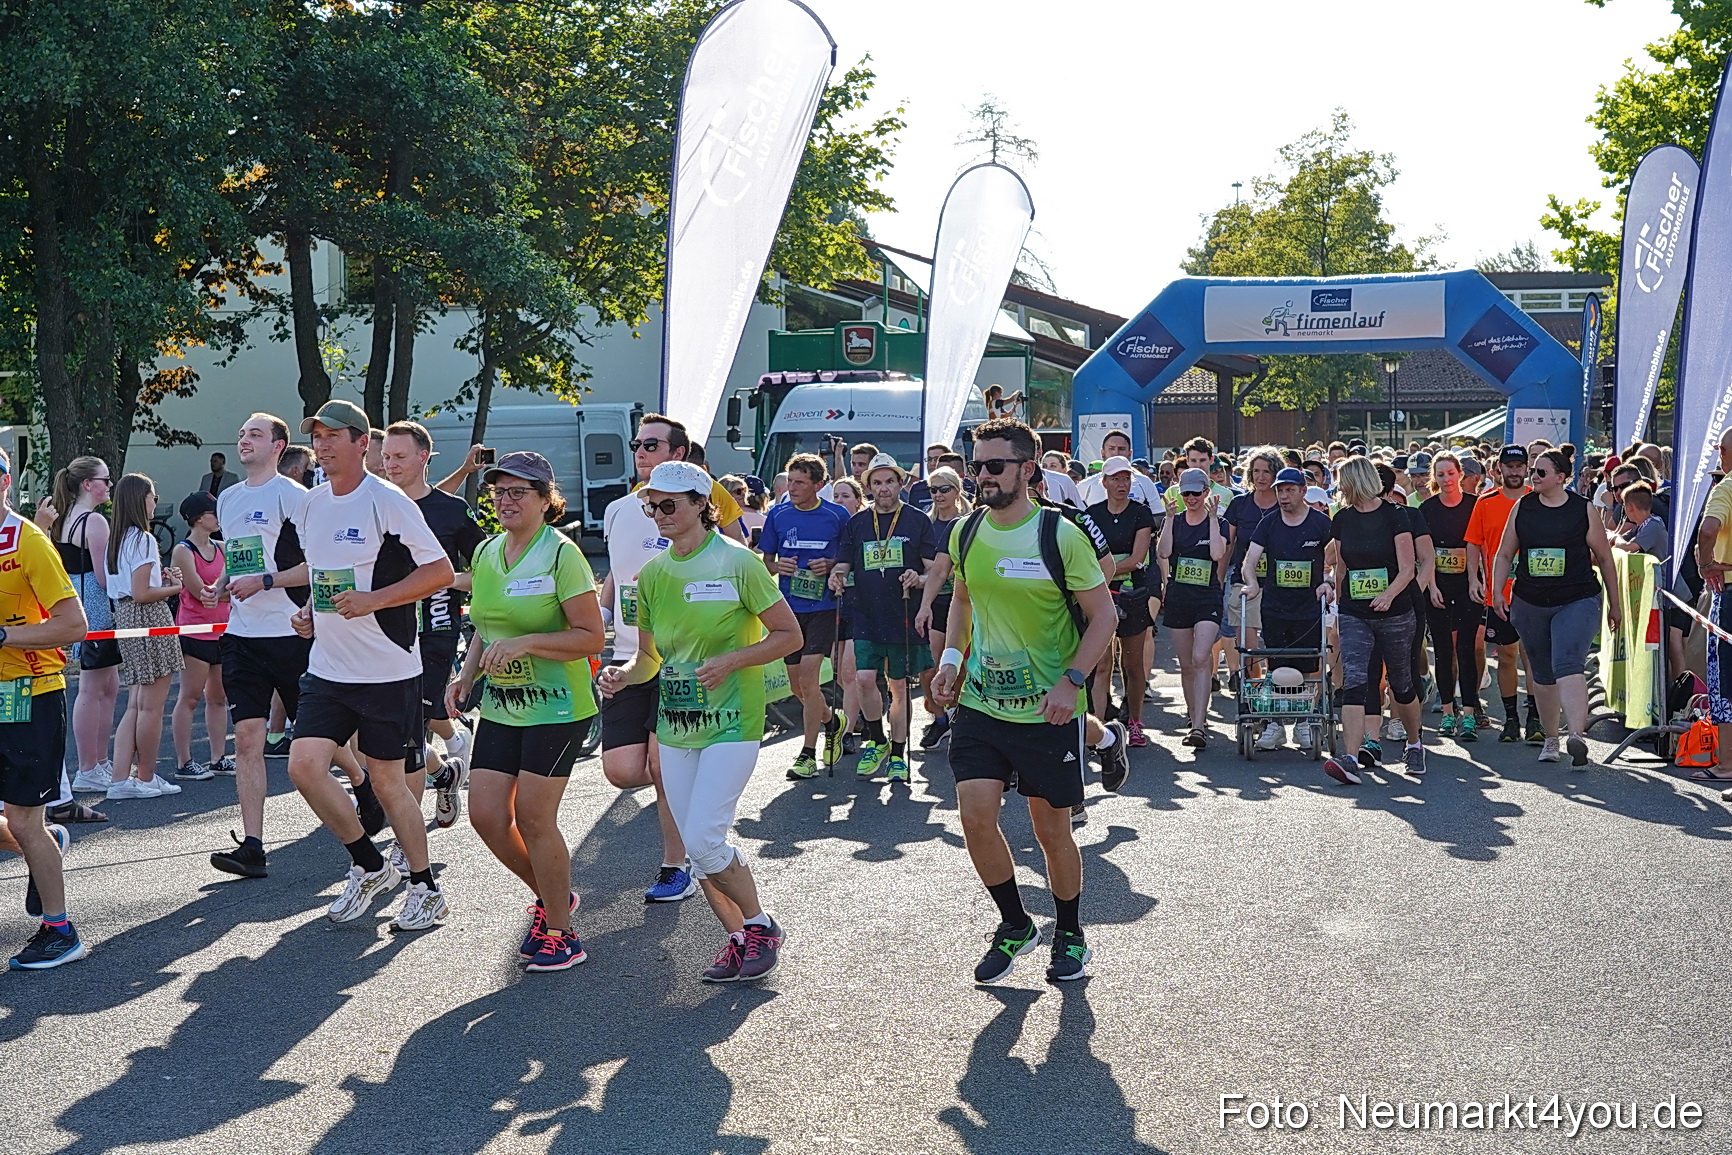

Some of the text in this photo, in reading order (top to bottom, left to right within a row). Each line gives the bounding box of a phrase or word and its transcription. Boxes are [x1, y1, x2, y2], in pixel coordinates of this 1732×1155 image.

[1646, 172, 1682, 273] Fischer
[1665, 186, 1690, 268] AUTOMOBILE
[1297, 311, 1385, 329] firmenlauf
[1126, 343, 1173, 353] Fischer
[784, 410, 823, 419] abavent
[232, 550, 253, 563] 540
[1440, 556, 1459, 565] 743
[1536, 558, 1555, 568] 747
[1184, 566, 1202, 577] 883
[1284, 569, 1302, 579] 890
[798, 578, 816, 590] 786
[1358, 579, 1379, 590] 749
[319, 584, 341, 599] 535
[523, 660, 532, 681] 2022
[987, 669, 1017, 685] 938
[1022, 668, 1033, 690] 2022
[666, 679, 691, 696] 925
[696, 681, 704, 703] 2022
